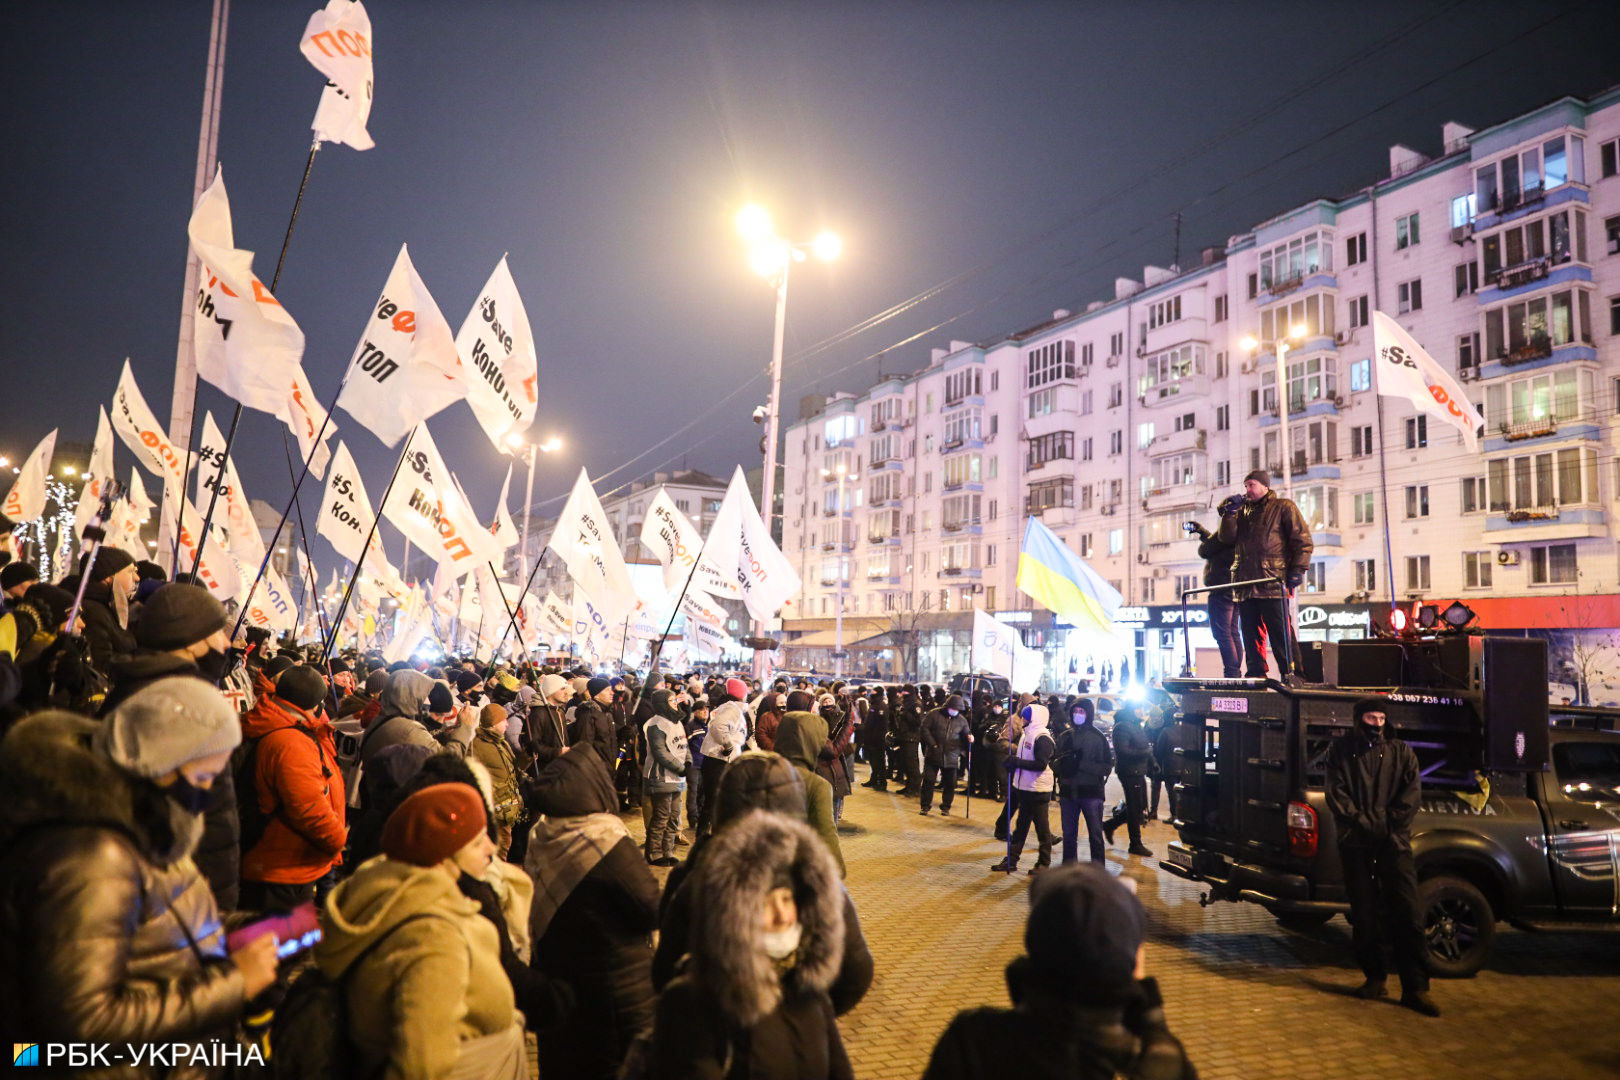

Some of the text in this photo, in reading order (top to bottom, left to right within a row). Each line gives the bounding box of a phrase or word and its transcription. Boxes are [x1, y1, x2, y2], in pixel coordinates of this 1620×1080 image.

[360, 339, 400, 384] ТОП
[200, 445, 230, 475] #S
[331, 501, 362, 535] Кон
